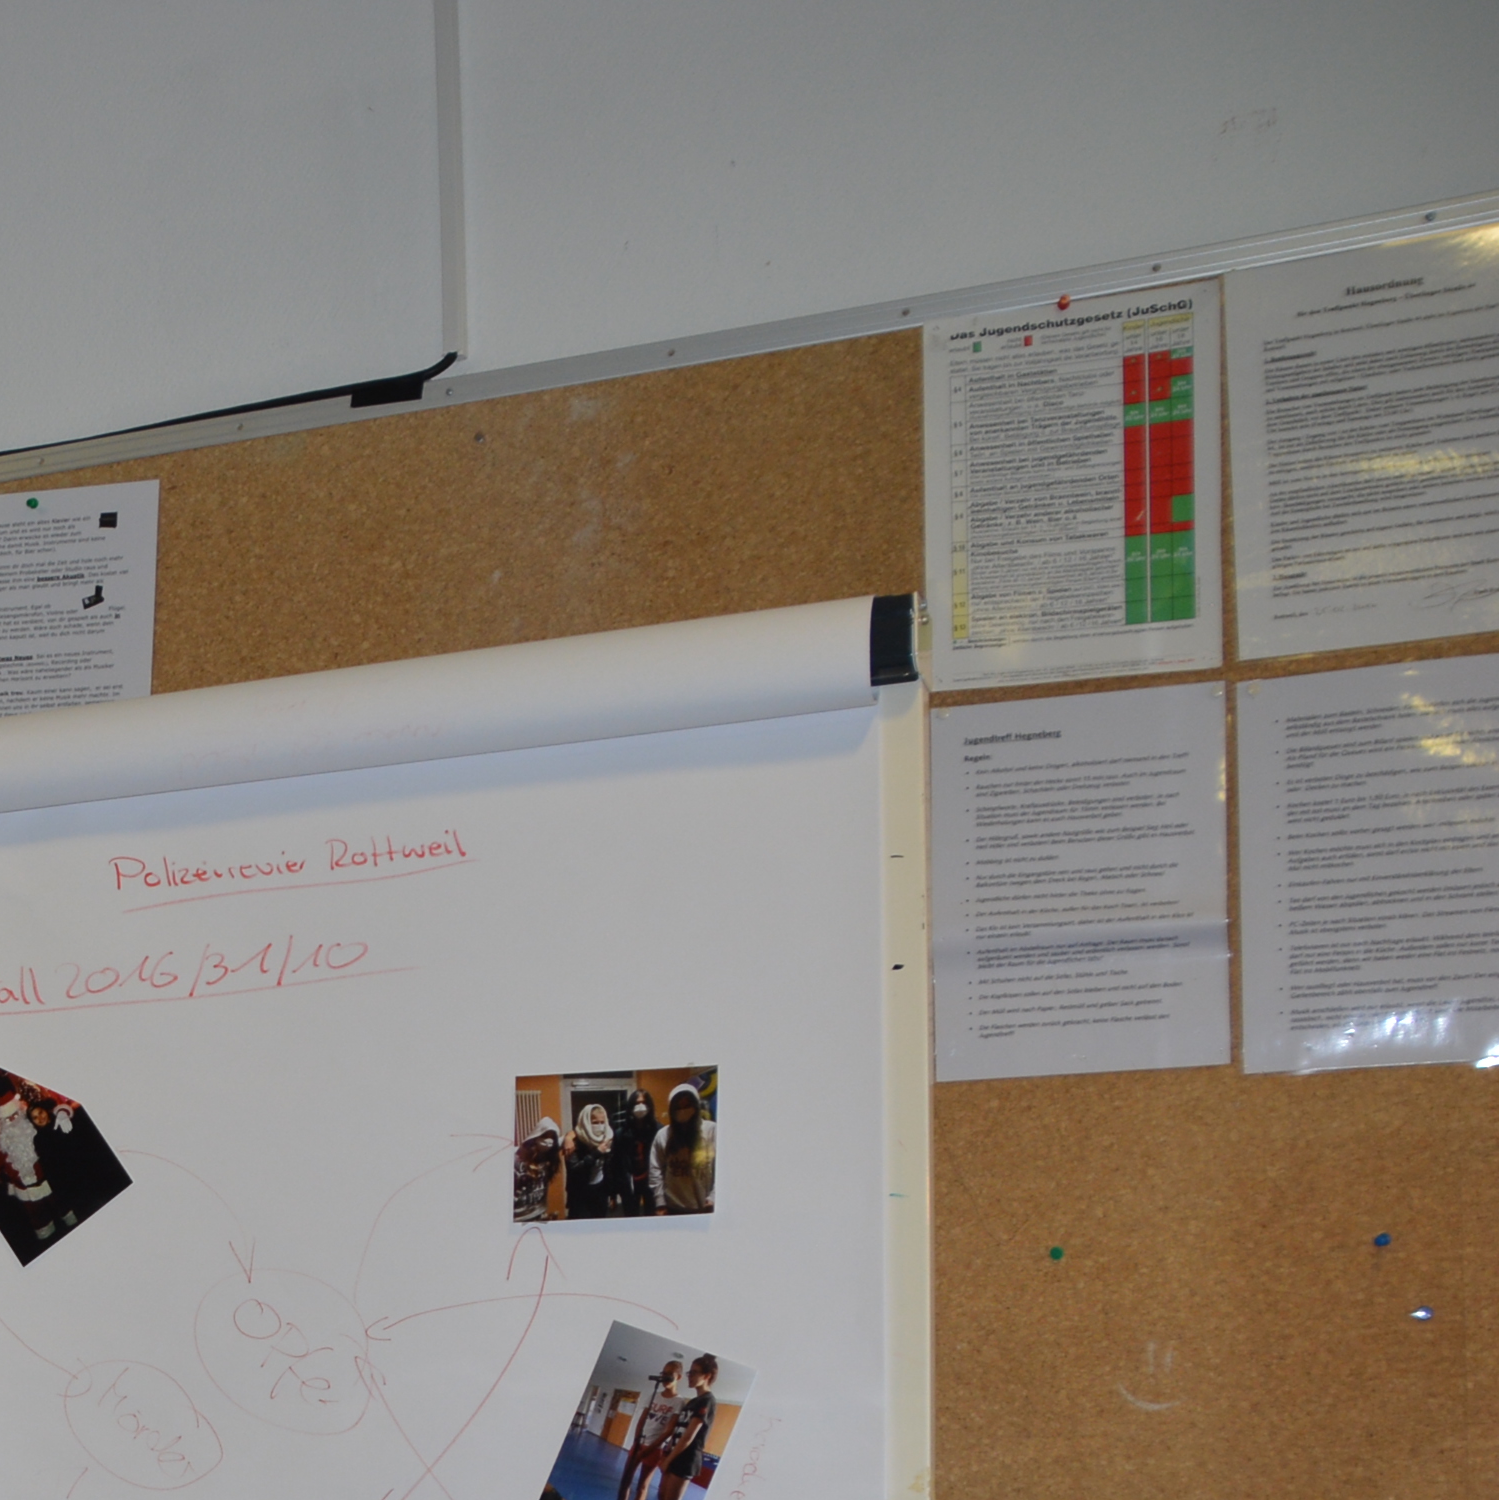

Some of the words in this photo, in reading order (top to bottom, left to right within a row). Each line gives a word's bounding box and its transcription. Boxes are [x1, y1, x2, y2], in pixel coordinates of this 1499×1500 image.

[1346, 277, 1424, 296] Hausordnung
[979, 311, 1124, 336] Jugendschutzgesetz
[1126, 299, 1193, 318] (JuSchG)
[109, 849, 306, 890] Polizeirevier
[326, 830, 467, 871] Rottweil
[54, 934, 369, 998] 2016/31/10
